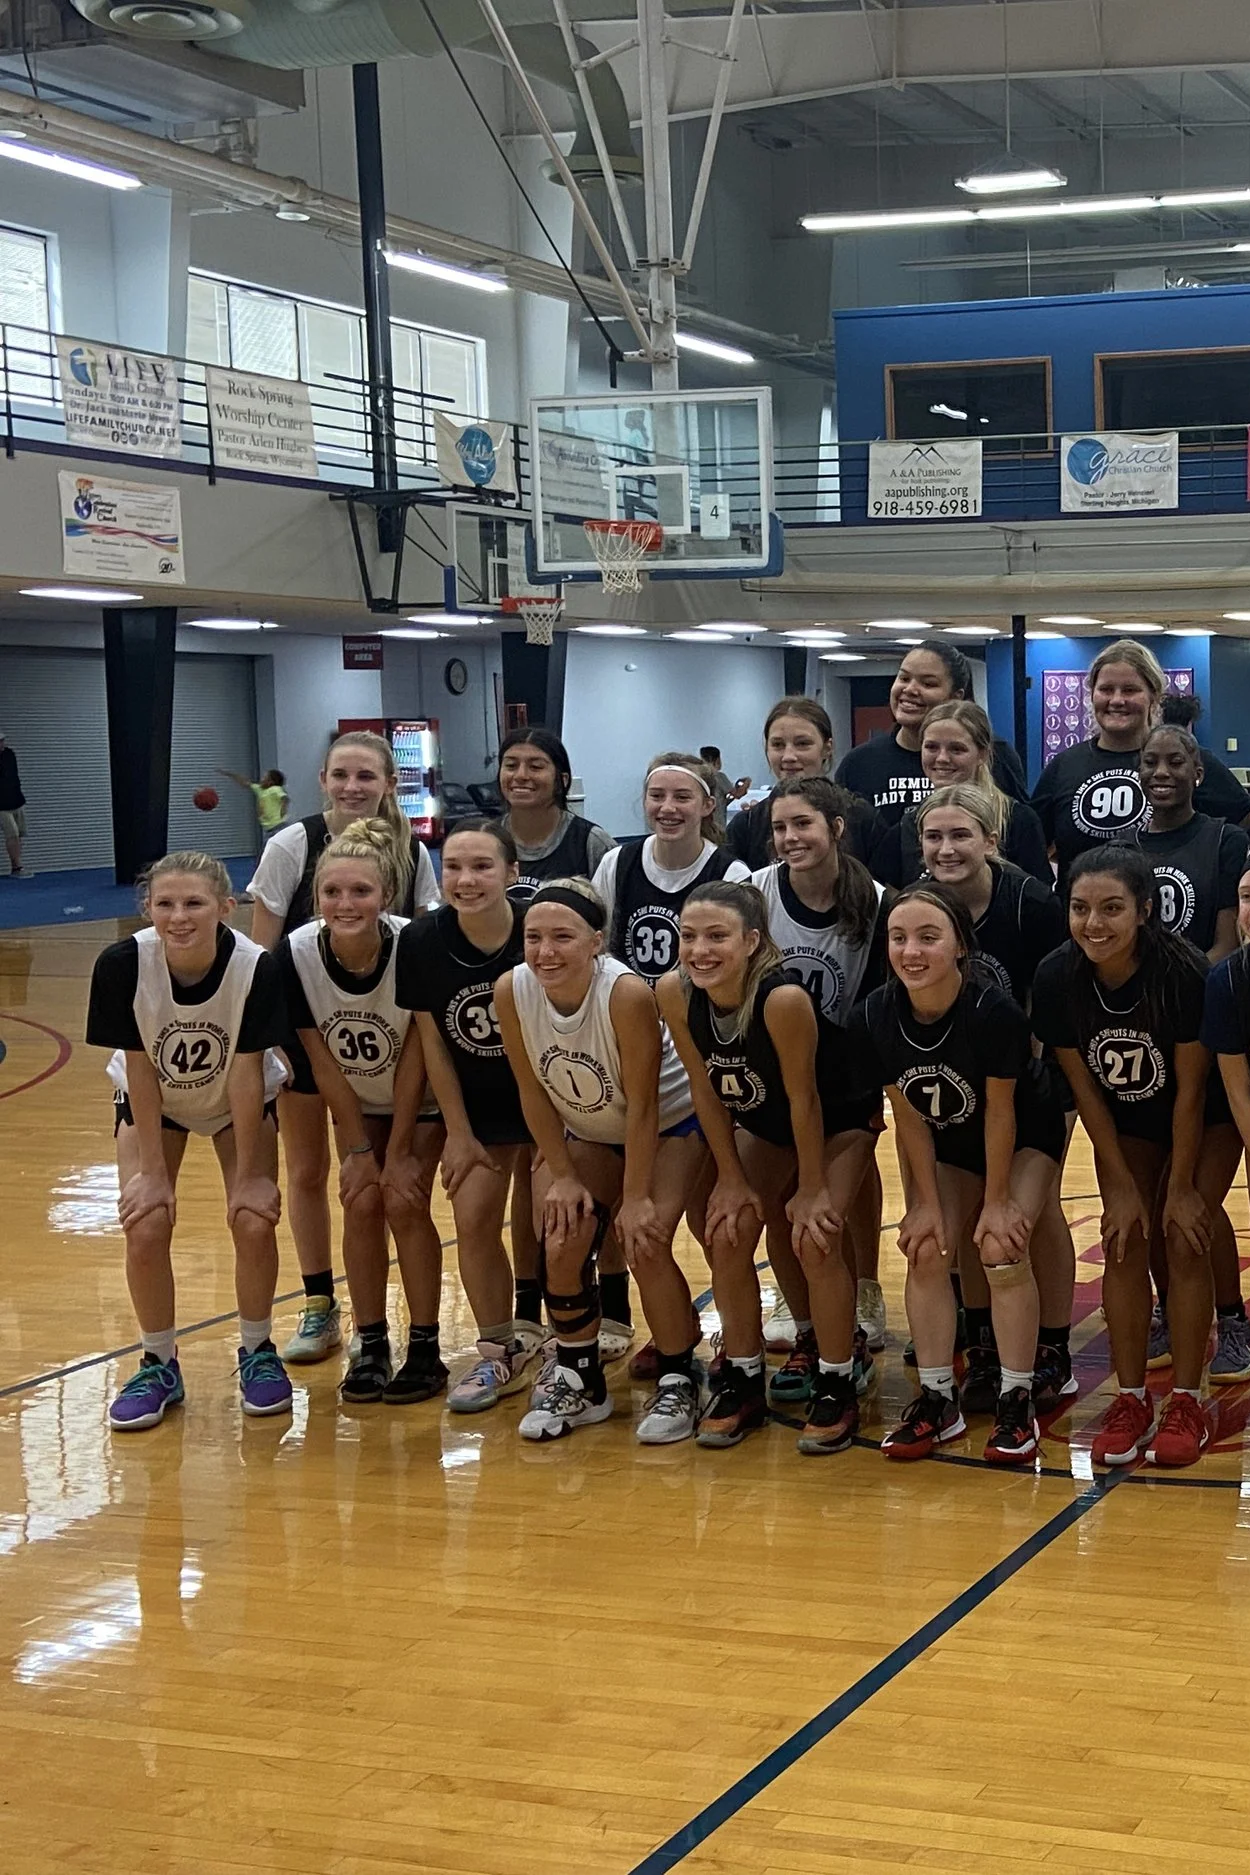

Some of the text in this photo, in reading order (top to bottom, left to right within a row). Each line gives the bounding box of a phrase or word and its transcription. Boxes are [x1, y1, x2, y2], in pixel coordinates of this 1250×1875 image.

[228, 380, 293, 408] Rock Spring
[216, 403, 304, 431] Worship Center
[217, 429, 245, 445] Pastor
[890, 469, 896, 477] A
[908, 469, 915, 477] A
[917, 468, 961, 477] PUBLISHING
[1089, 449, 1172, 485] grace
[1109, 464, 1172, 474] Christian Church
[885, 486, 968, 499] aapublishing.org
[710, 505, 719, 519] 4
[873, 499, 977, 515] 918-459-6981
[1091, 772, 1104, 782] SHE
[874, 791, 906, 807] LADY
[1090, 786, 1134, 819] 90
[1090, 829, 1115, 839] SKILLS
[1166, 866, 1195, 907] IN WORK SKILLS
[649, 905, 674, 918] PUTS IN
[636, 926, 672, 965] 33
[782, 946, 842, 972] SHE PUTS IN WORK
[471, 982, 490, 993] PUTS
[1129, 1030, 1137, 1038] IN
[338, 1028, 380, 1061] 36
[170, 1038, 212, 1073] 42
[580, 1052, 598, 1068] WORK
[905, 1065, 936, 1077] SHE PUTS
[943, 1064, 962, 1082] WORK
[1104, 1047, 1144, 1084] 27
[566, 1069, 583, 1098] 1
[721, 1074, 743, 1096] 4
[922, 1082, 940, 1116] 7
